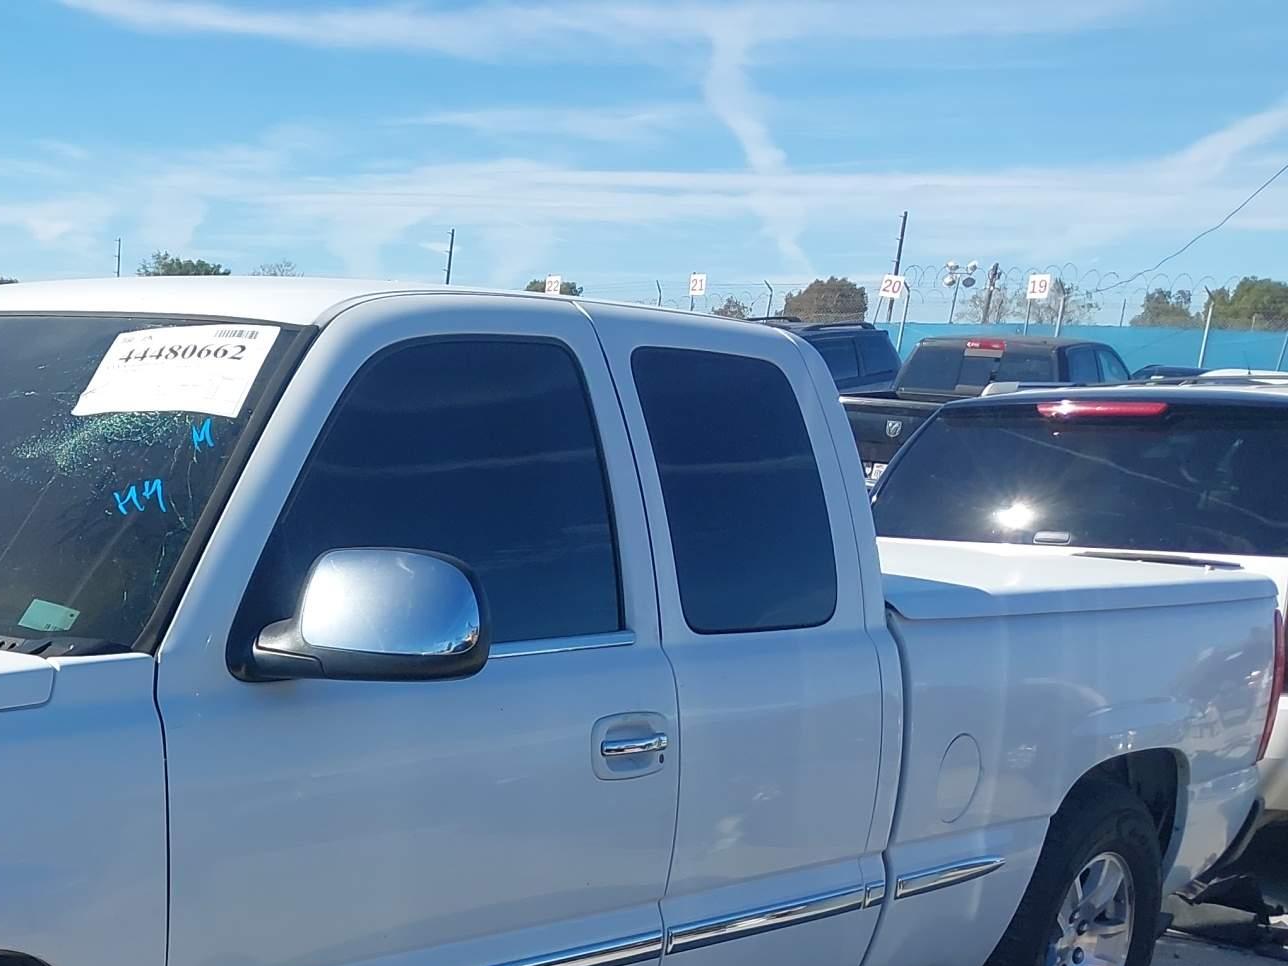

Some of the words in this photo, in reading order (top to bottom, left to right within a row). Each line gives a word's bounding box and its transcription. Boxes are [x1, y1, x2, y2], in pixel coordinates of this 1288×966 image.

[546, 280, 559, 292] 22
[691, 279, 704, 291] 21
[882, 279, 902, 294] 20
[1029, 279, 1048, 294] 19
[119, 343, 247, 363] 44480662
